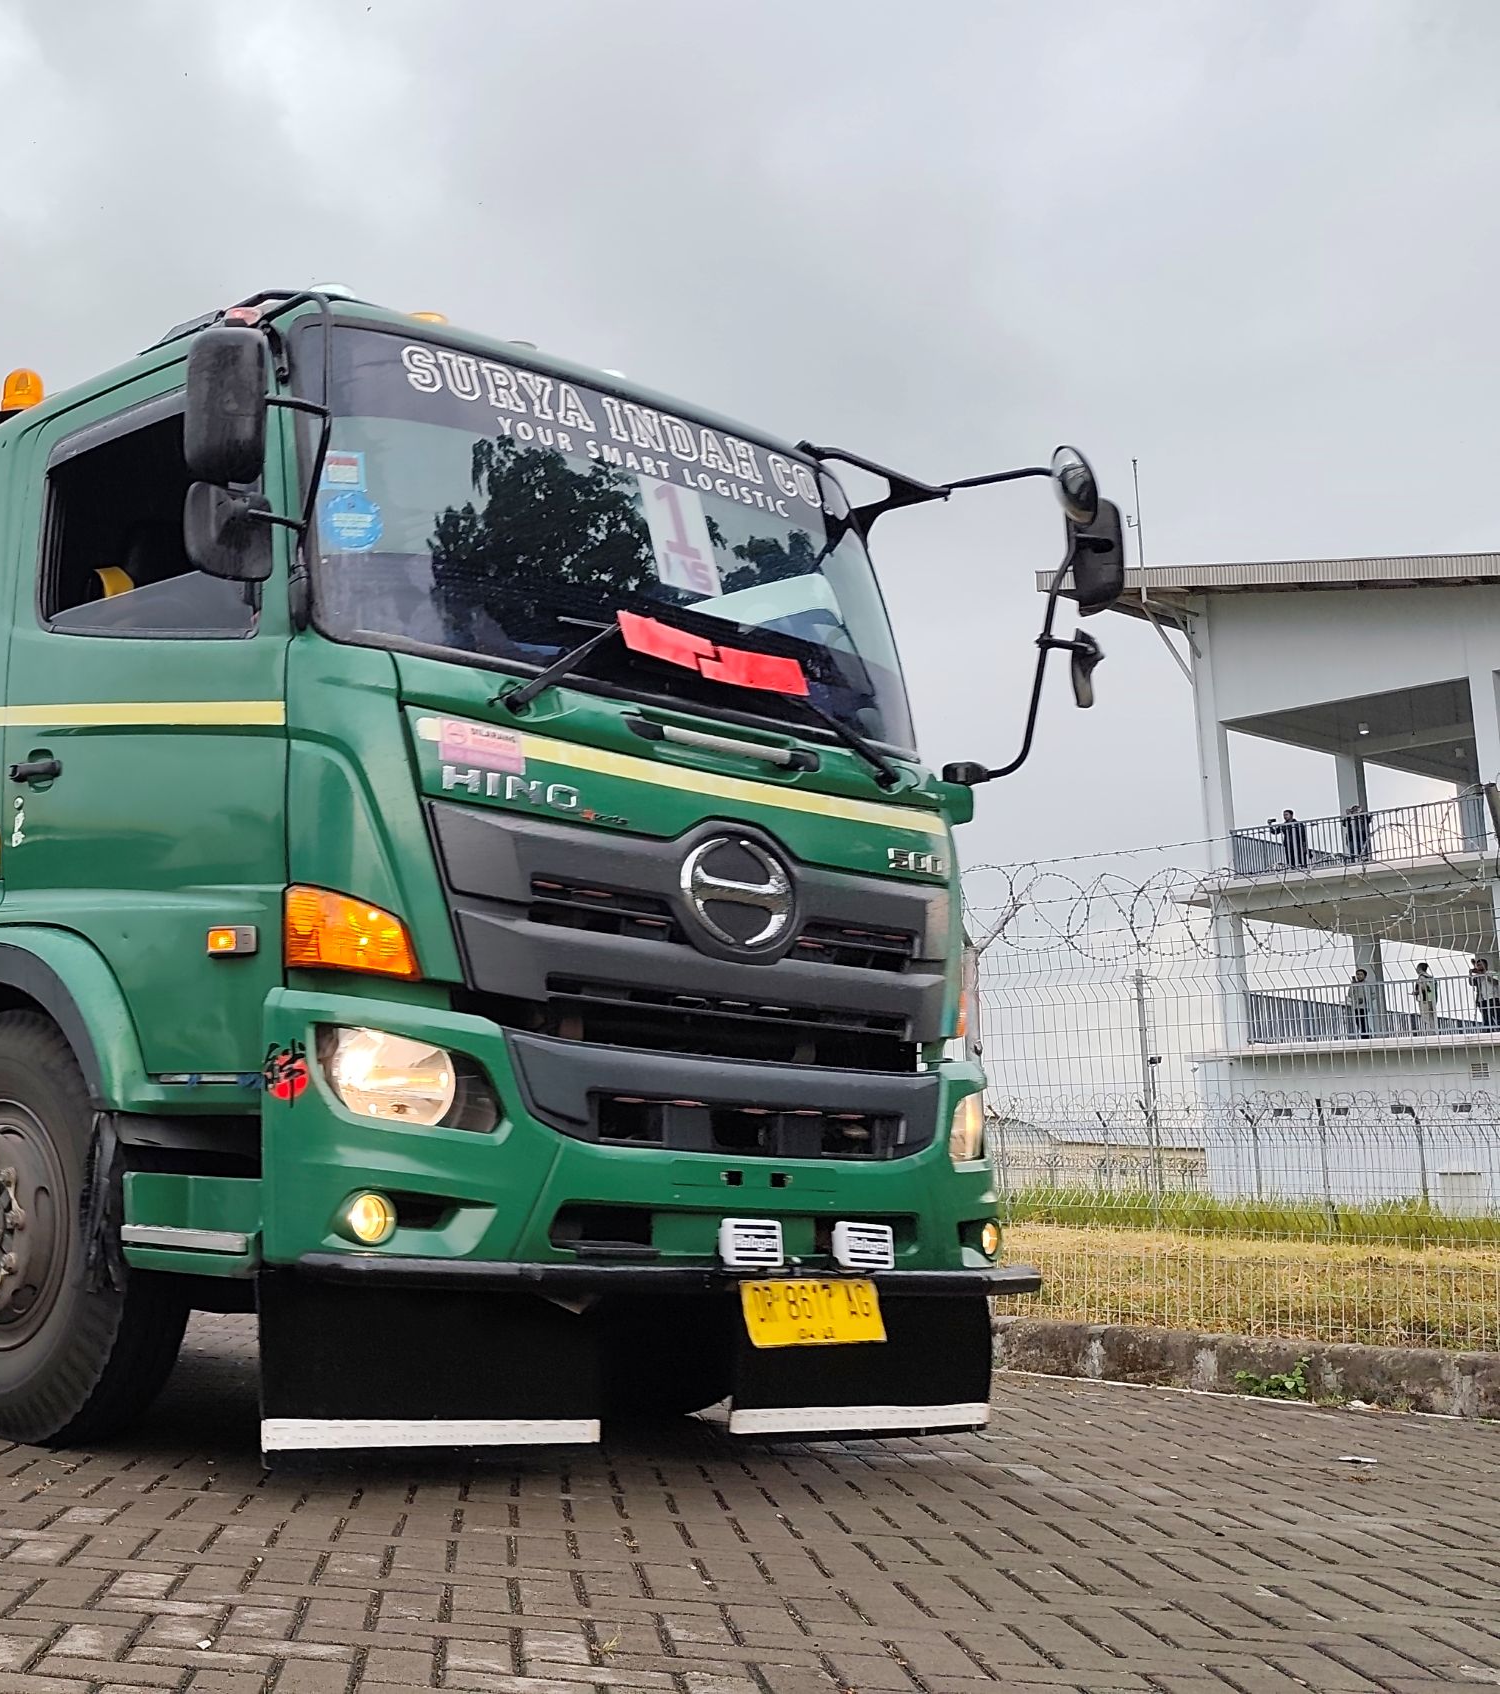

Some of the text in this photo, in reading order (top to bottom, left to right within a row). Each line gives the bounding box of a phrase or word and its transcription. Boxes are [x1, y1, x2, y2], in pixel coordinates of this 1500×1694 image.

[401, 345, 596, 433] SURYA
[602, 397, 765, 485] INDAH
[497, 416, 790, 518] YOUR SMART LOGISTIC
[653, 483, 702, 560] 1
[442, 765, 581, 815] HINO
[887, 847, 944, 876] 500
[786, 1284, 835, 1320] 8617
[844, 1284, 871, 1318] AG
